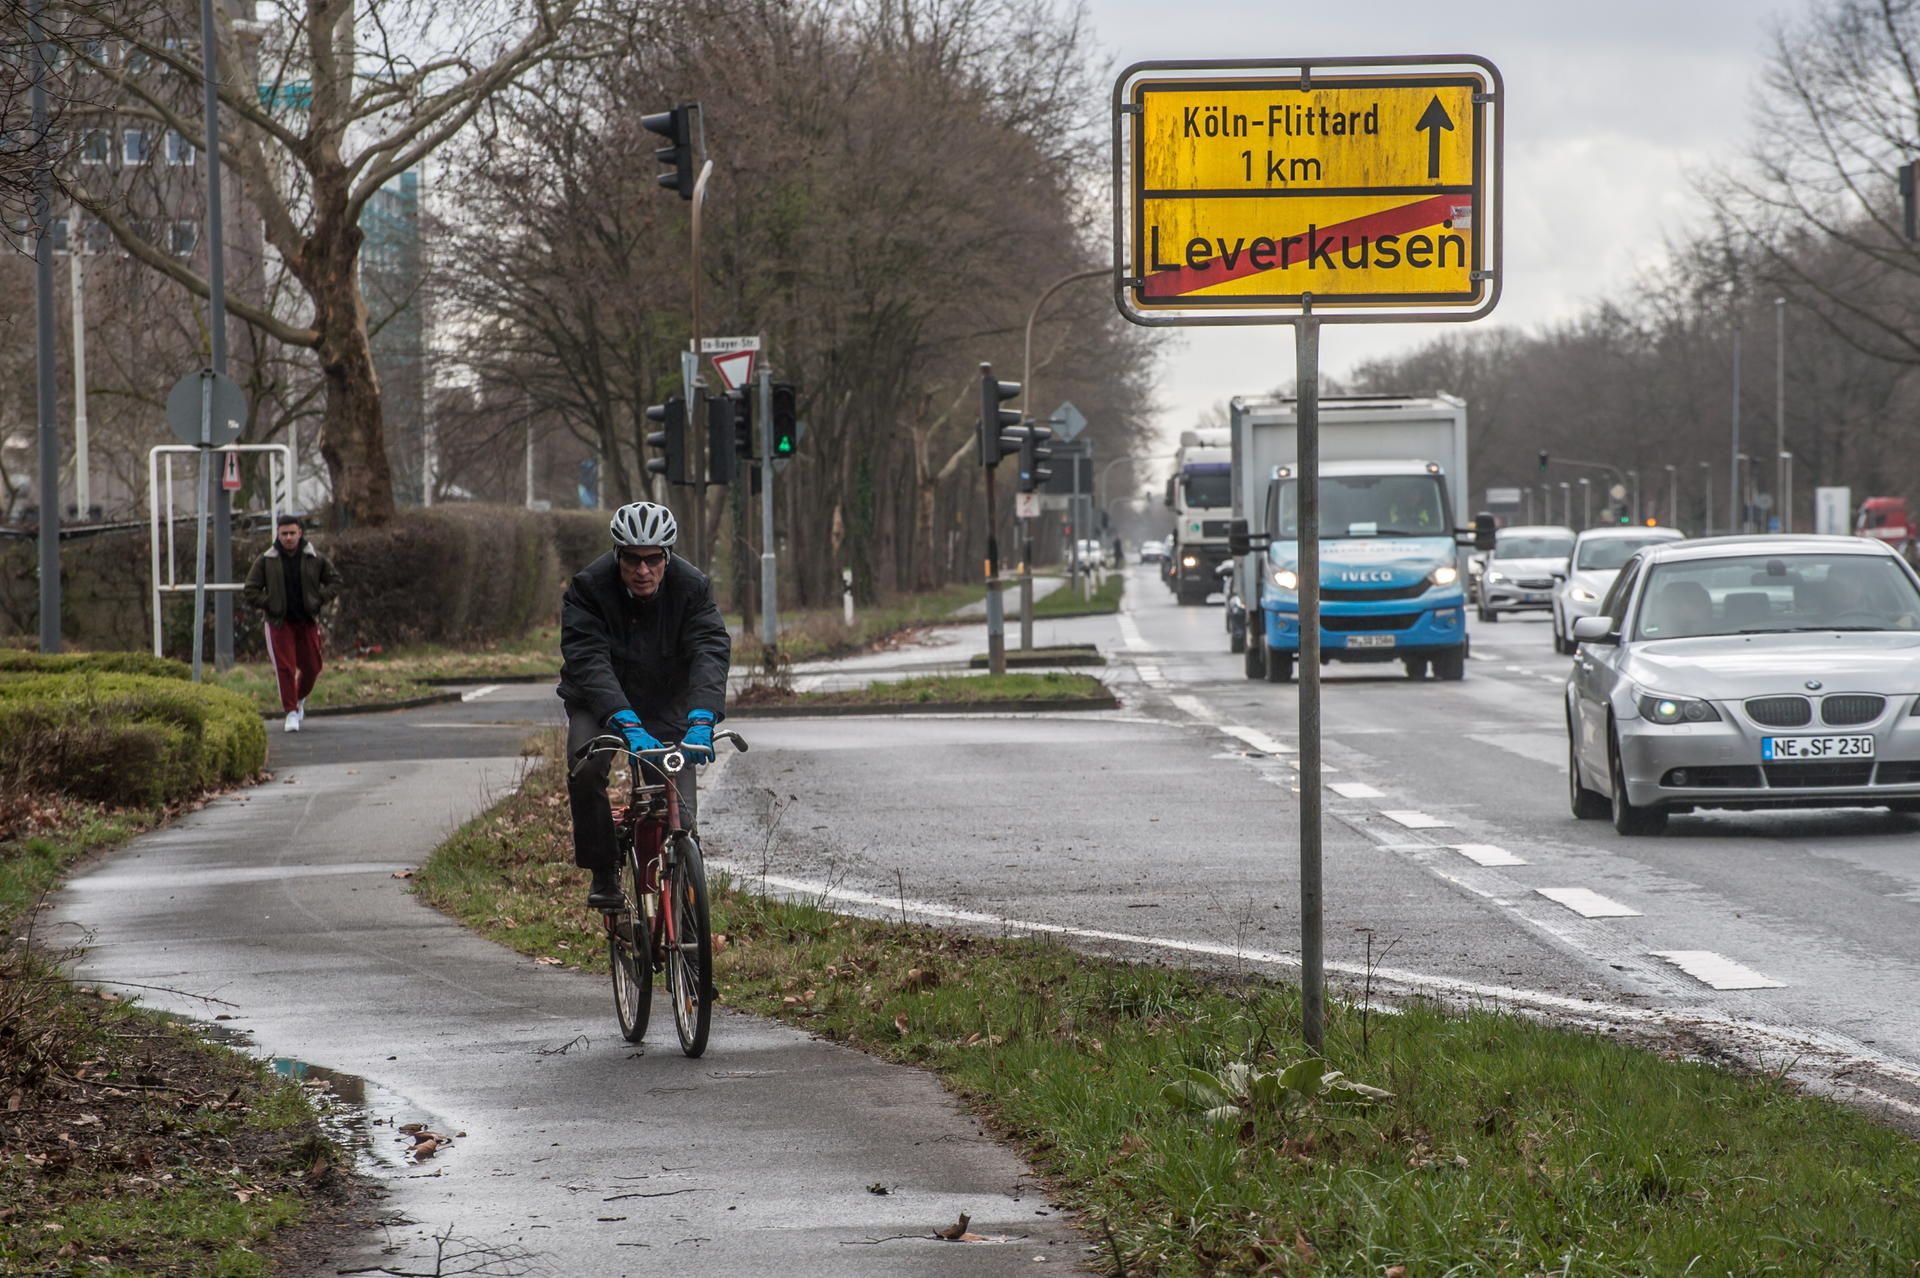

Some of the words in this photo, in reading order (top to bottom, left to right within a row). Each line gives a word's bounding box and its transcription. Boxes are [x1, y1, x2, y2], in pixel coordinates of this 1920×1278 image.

[1184, 103, 1379, 138] Köln-Flittard
[1241, 150, 1252, 182] 1
[1267, 149, 1322, 182] km
[1151, 223, 1466, 272] Leverkusen
[1341, 571, 1393, 582] IVECO
[1774, 739, 1798, 757] NE
[1811, 738, 1833, 756] SF
[1838, 737, 1871, 755] 230
